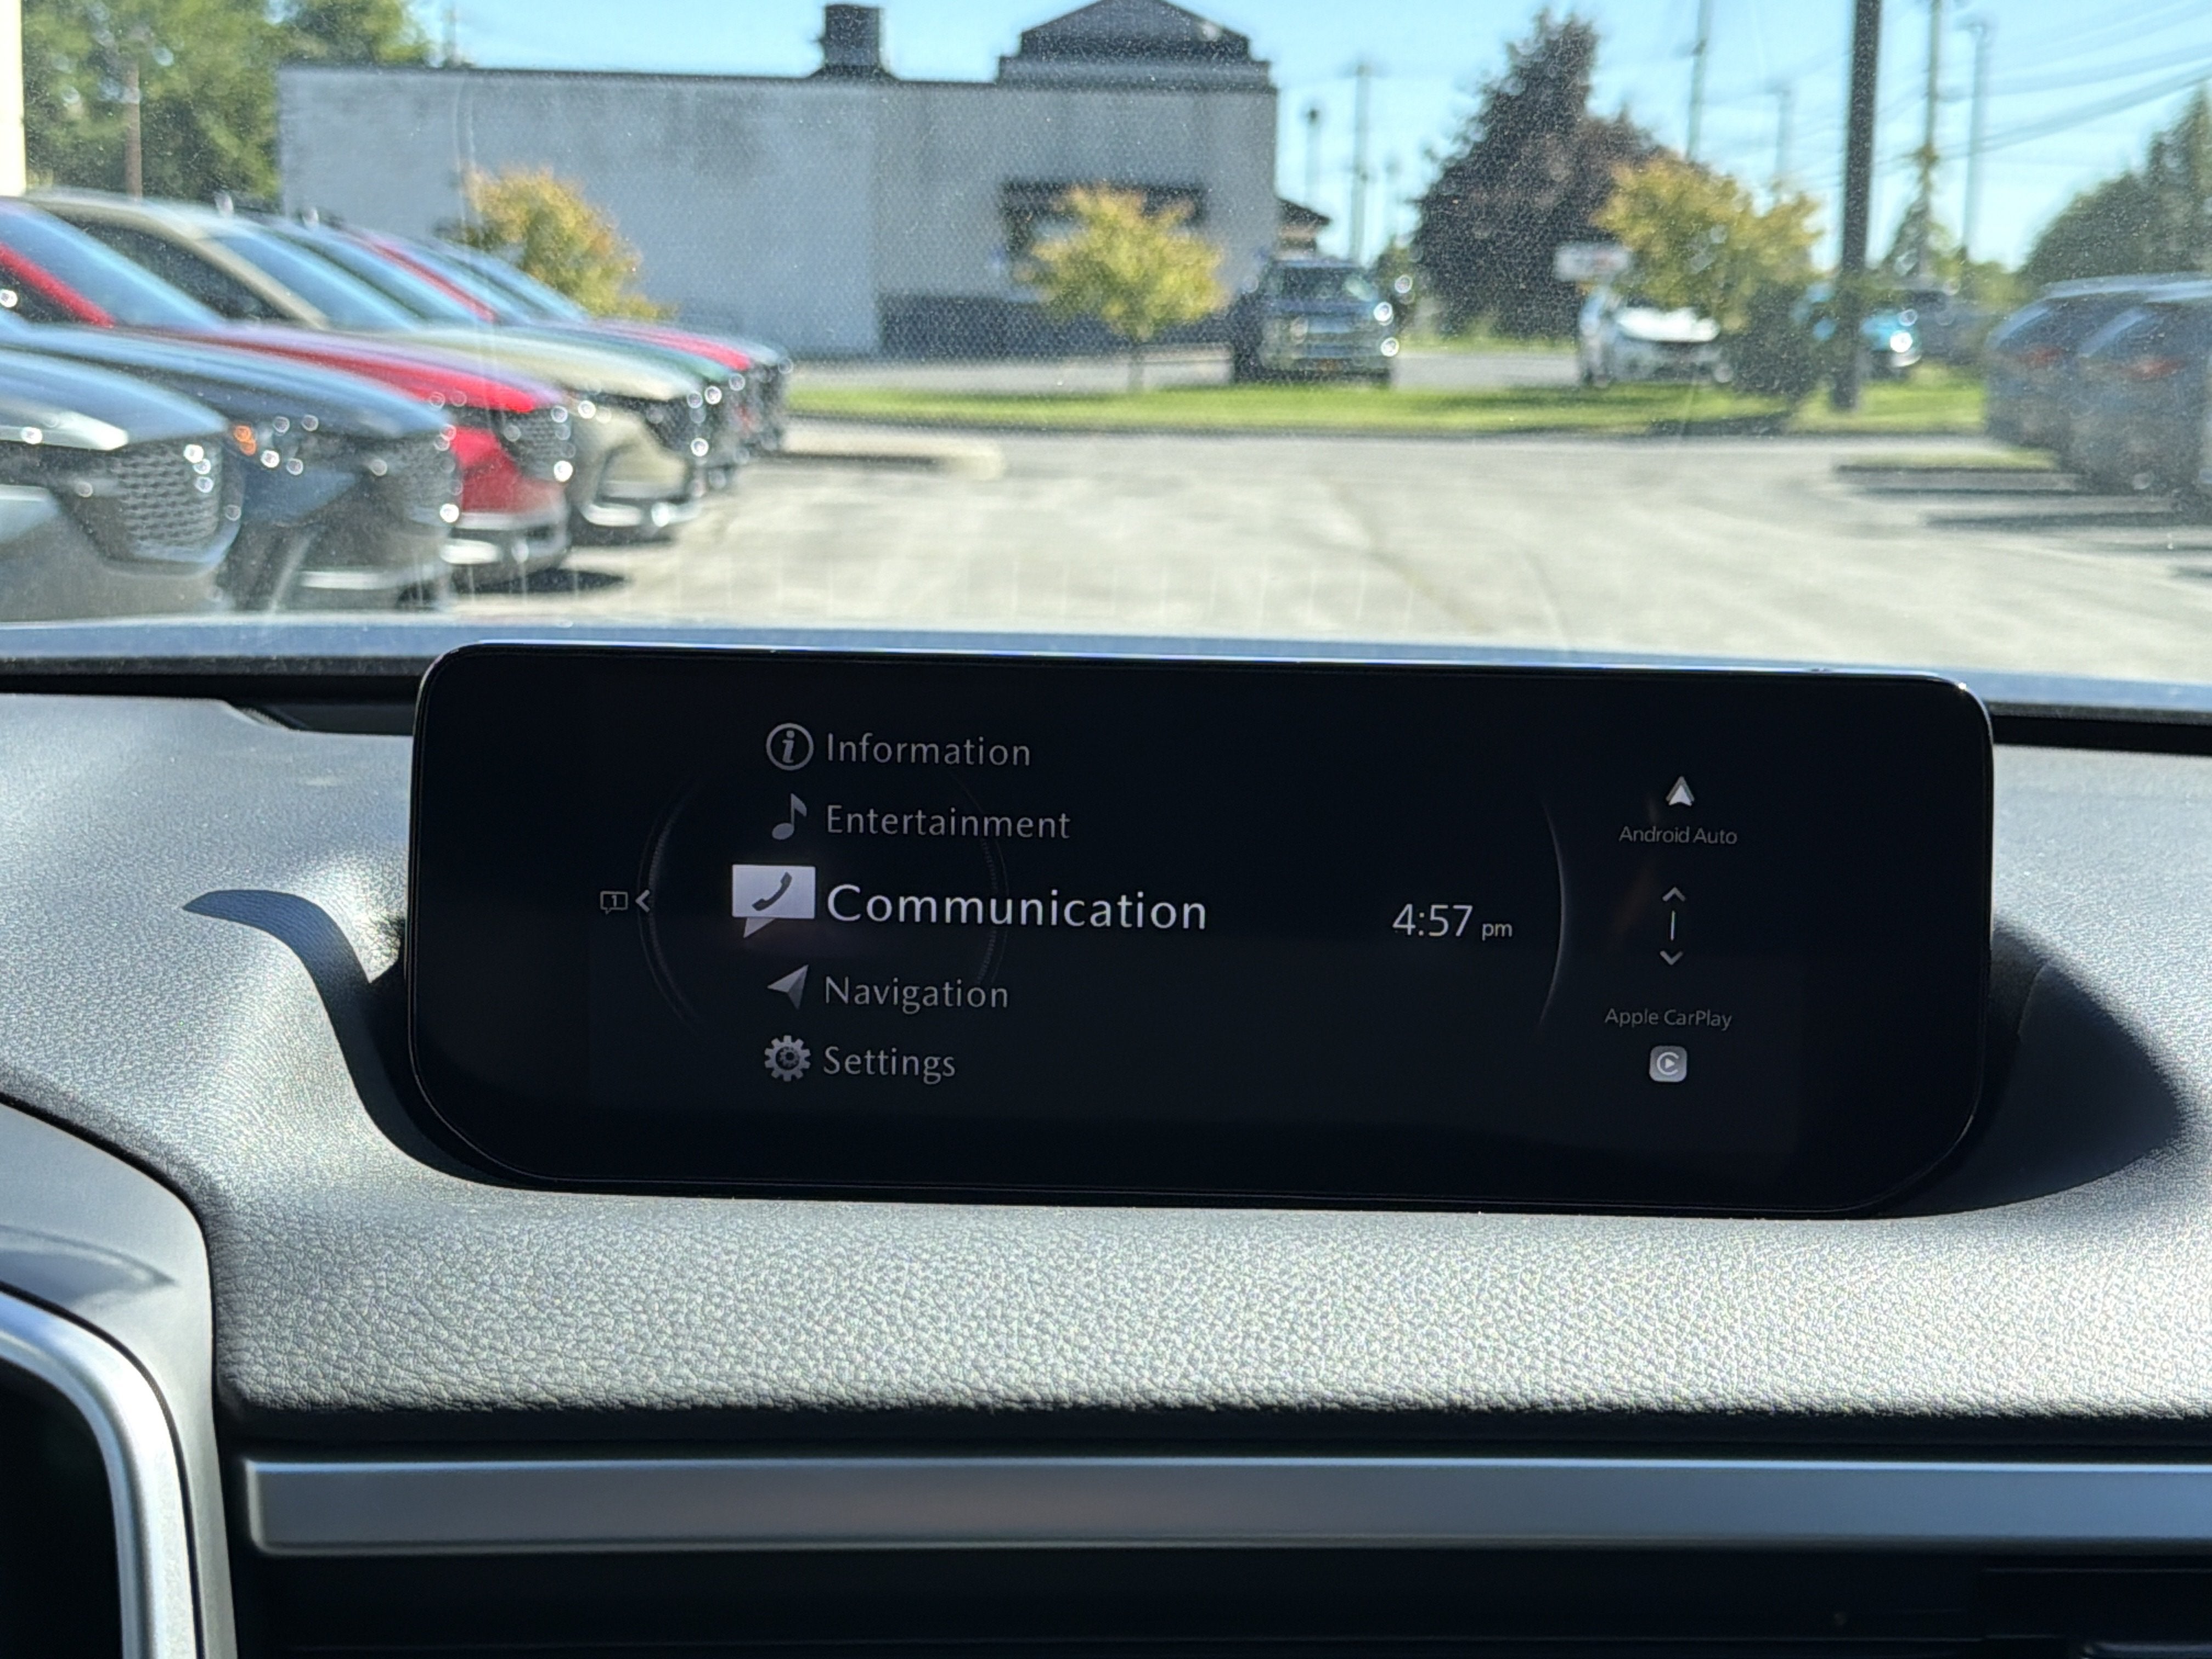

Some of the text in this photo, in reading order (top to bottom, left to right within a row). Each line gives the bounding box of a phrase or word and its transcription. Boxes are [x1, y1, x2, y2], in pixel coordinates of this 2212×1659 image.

[827, 732, 1030, 766] Information
[827, 804, 1071, 839] Entertainment
[1618, 825, 1738, 845] Android Auto
[827, 883, 1206, 930] Communication
[1392, 903, 1513, 941] 4:57 pm
[825, 975, 1009, 1015] Navigation
[1604, 1007, 1733, 1031] Apple CarPlay
[823, 1045, 956, 1085] Settings
